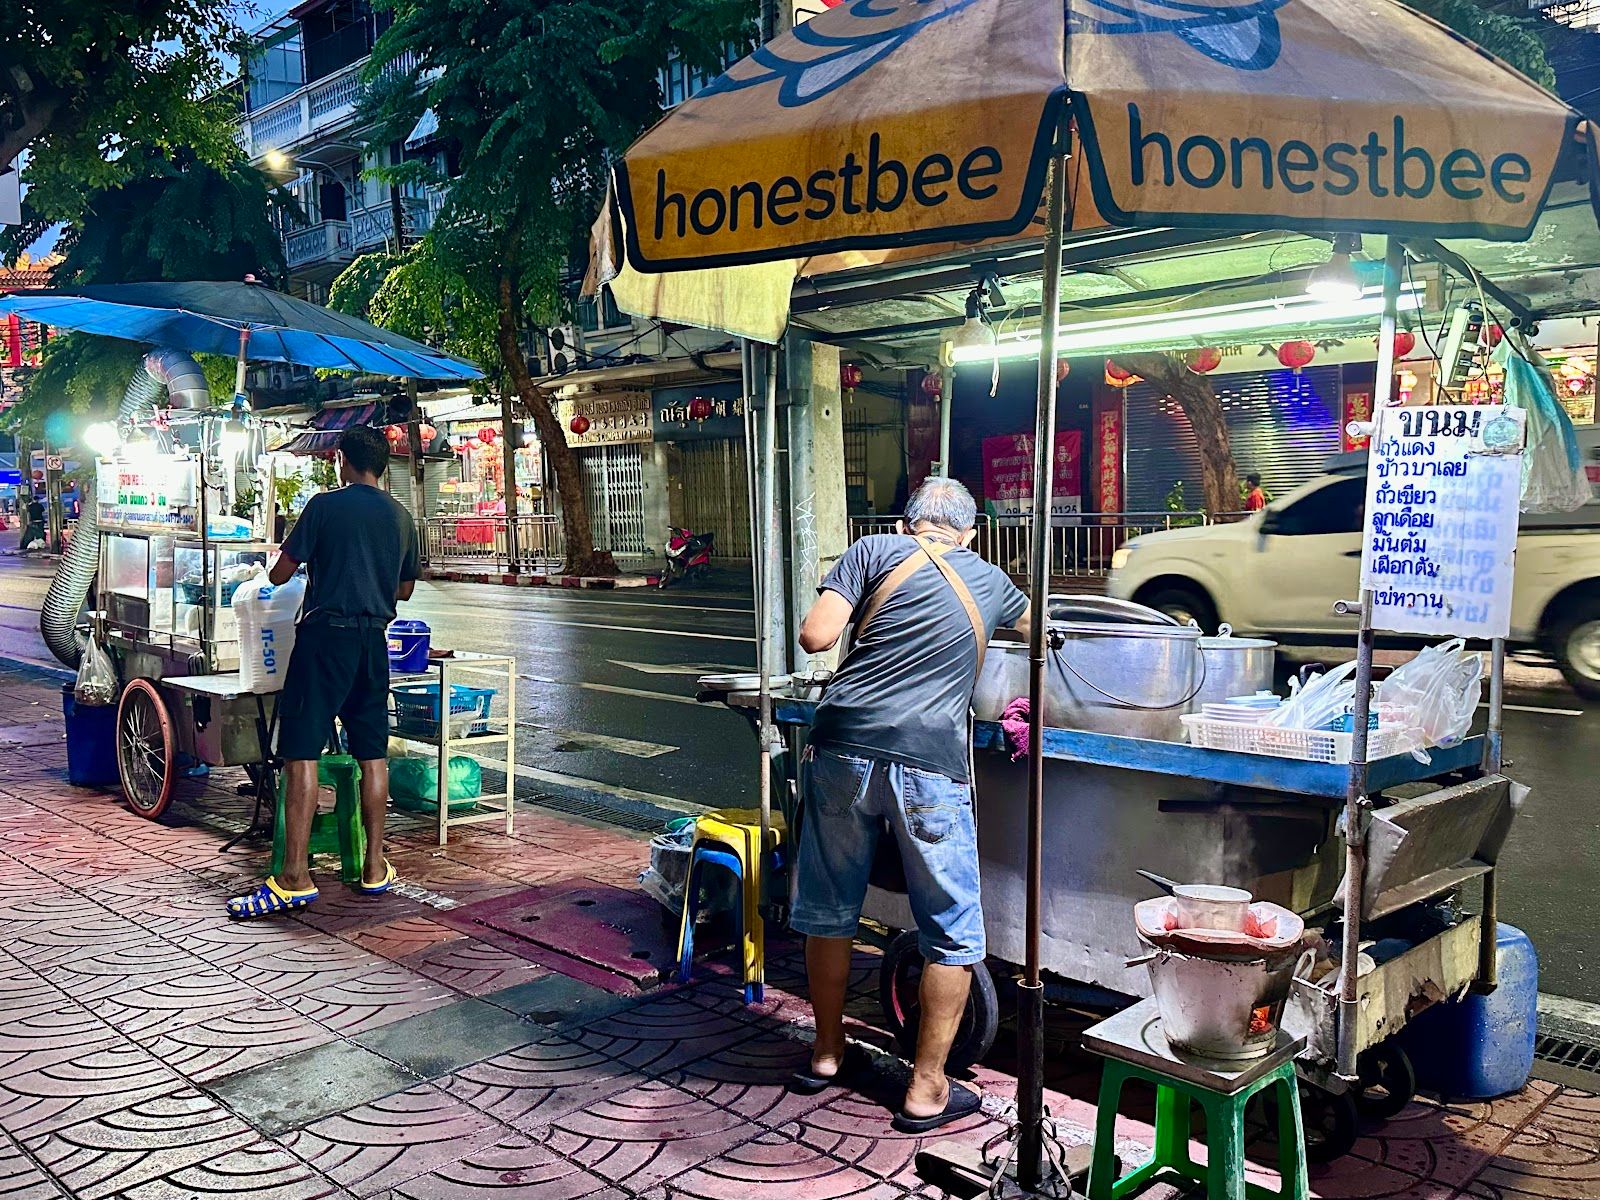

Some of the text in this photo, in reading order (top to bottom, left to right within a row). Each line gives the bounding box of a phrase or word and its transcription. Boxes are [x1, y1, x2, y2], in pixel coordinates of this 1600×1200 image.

[1128, 101, 1532, 203] honestbee
[654, 132, 1003, 240] honestbee
[1399, 411, 1482, 437] ขนม
[1376, 481, 1436, 504] ถั่วเขียว
[1372, 507, 1434, 534] ลูกเดือย
[261, 629, 276, 674] IT-501
